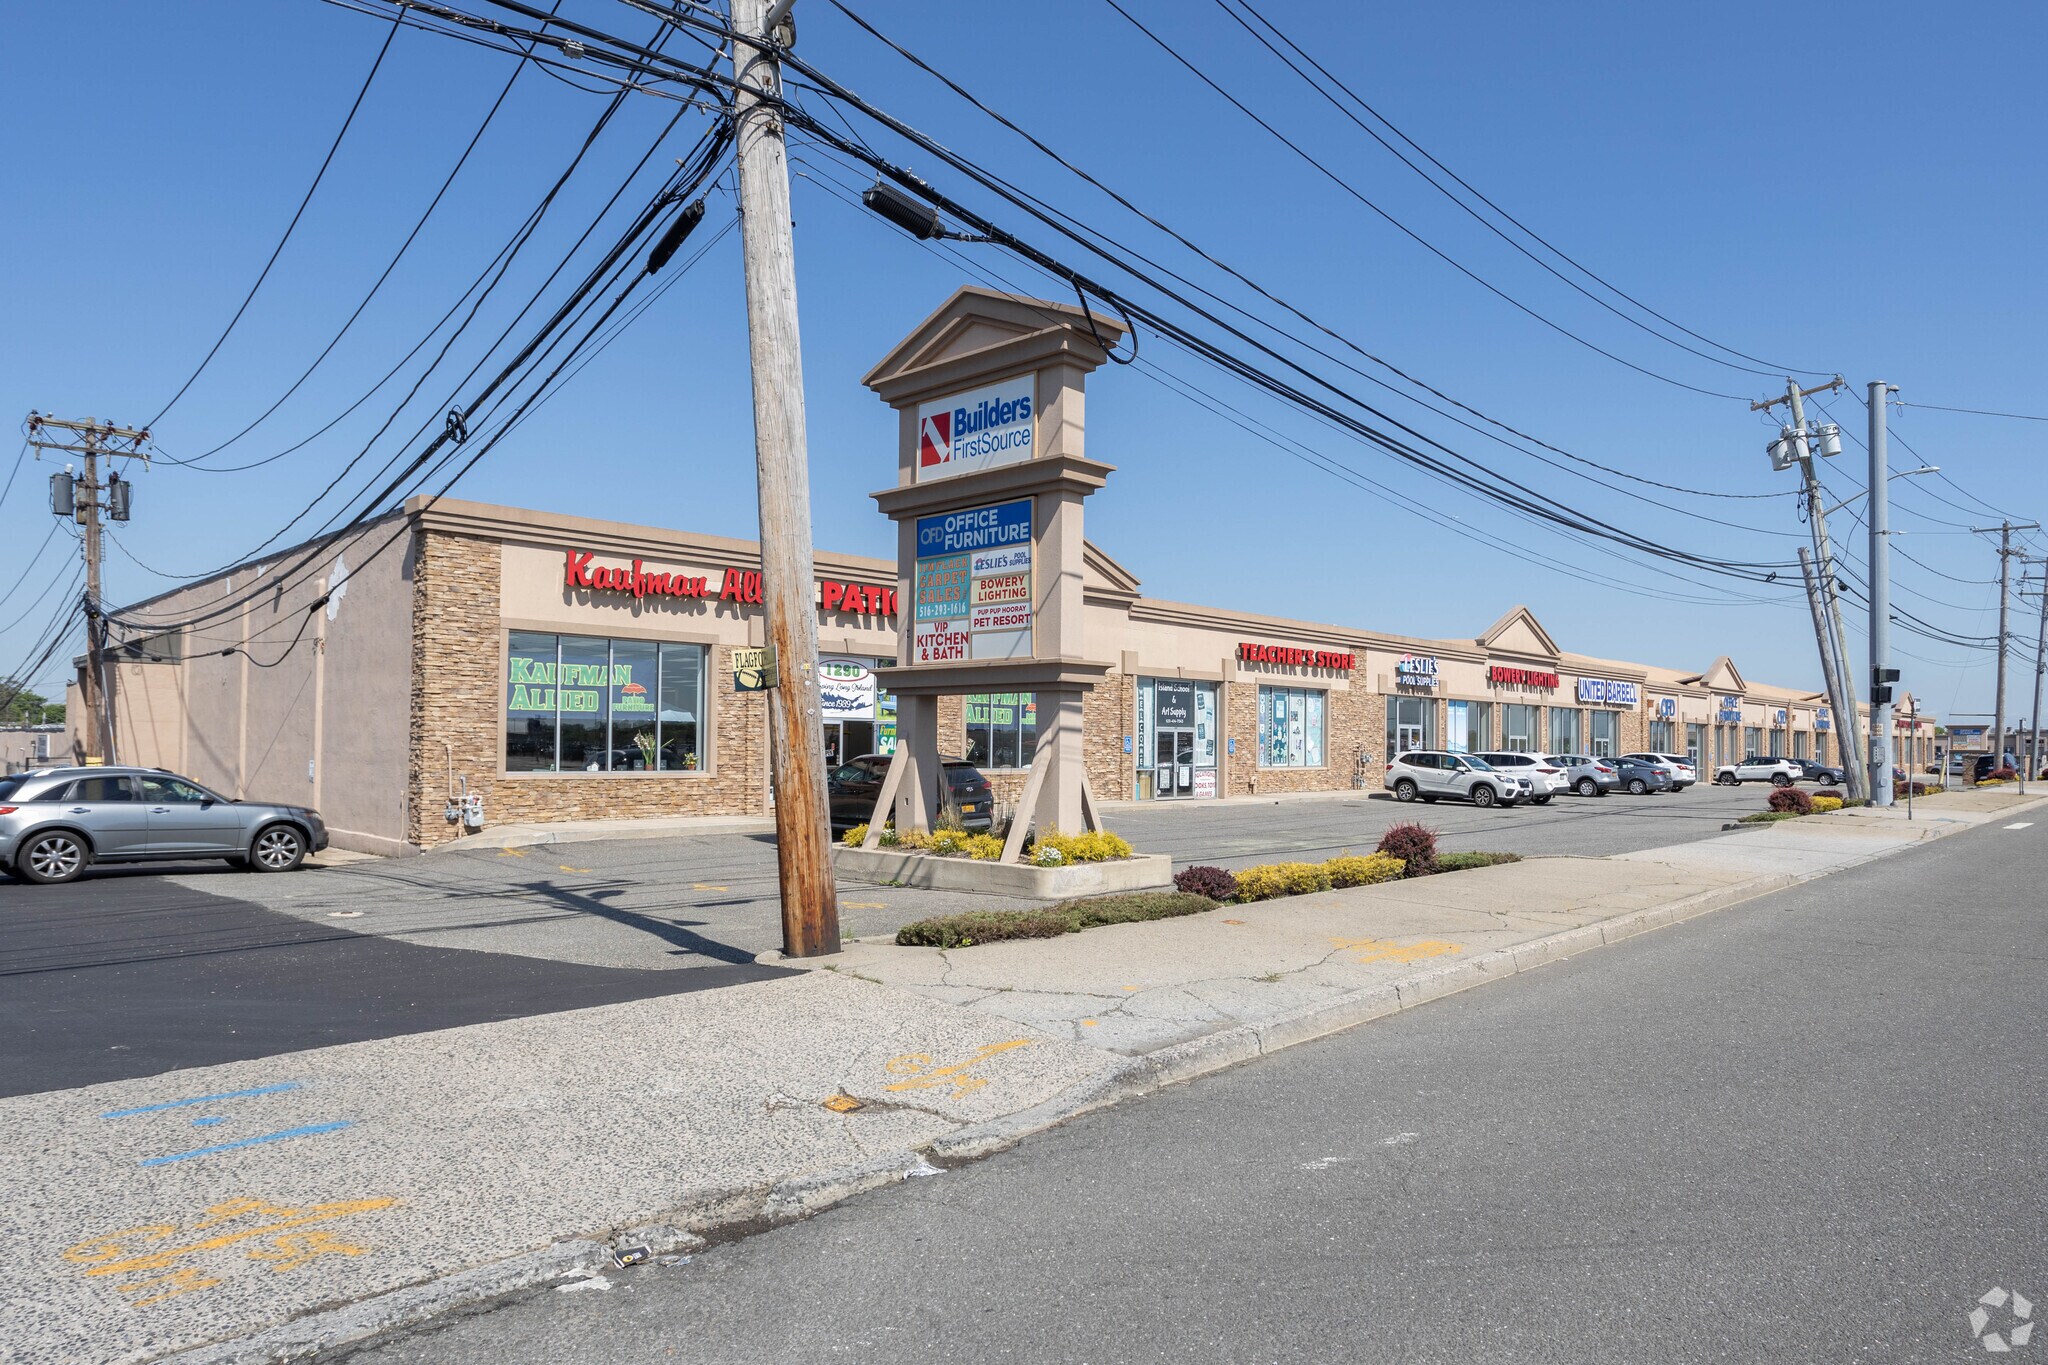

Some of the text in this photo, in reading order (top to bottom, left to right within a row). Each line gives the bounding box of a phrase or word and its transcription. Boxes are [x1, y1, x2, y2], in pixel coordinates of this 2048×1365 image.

[954, 396, 1031, 437] Builders
[953, 429, 1031, 460] FirstSource
[944, 509, 998, 533] OFFICE
[921, 527, 944, 545] OFD
[944, 522, 1030, 550] FURNITURE
[936, 558, 968, 570] FLACK
[975, 555, 1008, 570] LESLIE'S
[1009, 557, 1032, 567] SUPPLIES
[566, 550, 763, 604] Kaufman All
[919, 570, 968, 588] CARPET
[980, 575, 1025, 590] BOWERY
[823, 581, 897, 615] PATI
[919, 586, 960, 605] SALES
[978, 587, 1027, 602] LIGHTING
[919, 602, 966, 617] 516-293-1616
[989, 607, 1001, 615] PUP
[1001, 605, 1027, 614] HOORAY
[934, 622, 949, 633] VIP
[973, 613, 1031, 628] PET RESORT
[917, 632, 969, 648] KITCHEN
[921, 646, 963, 661] & BATH
[1241, 643, 1356, 670] TEACHER'S STORE
[509, 657, 632, 686] KAUFMAN
[826, 663, 860, 678] 1290
[1403, 656, 1439, 675] LESLIE'S
[1491, 666, 1560, 688] BOWERY LIGHTING
[509, 685, 599, 712] ALLIED
[1578, 677, 1638, 703] UNITED BARBELL
[1161, 706, 1187, 719] Art Supply
